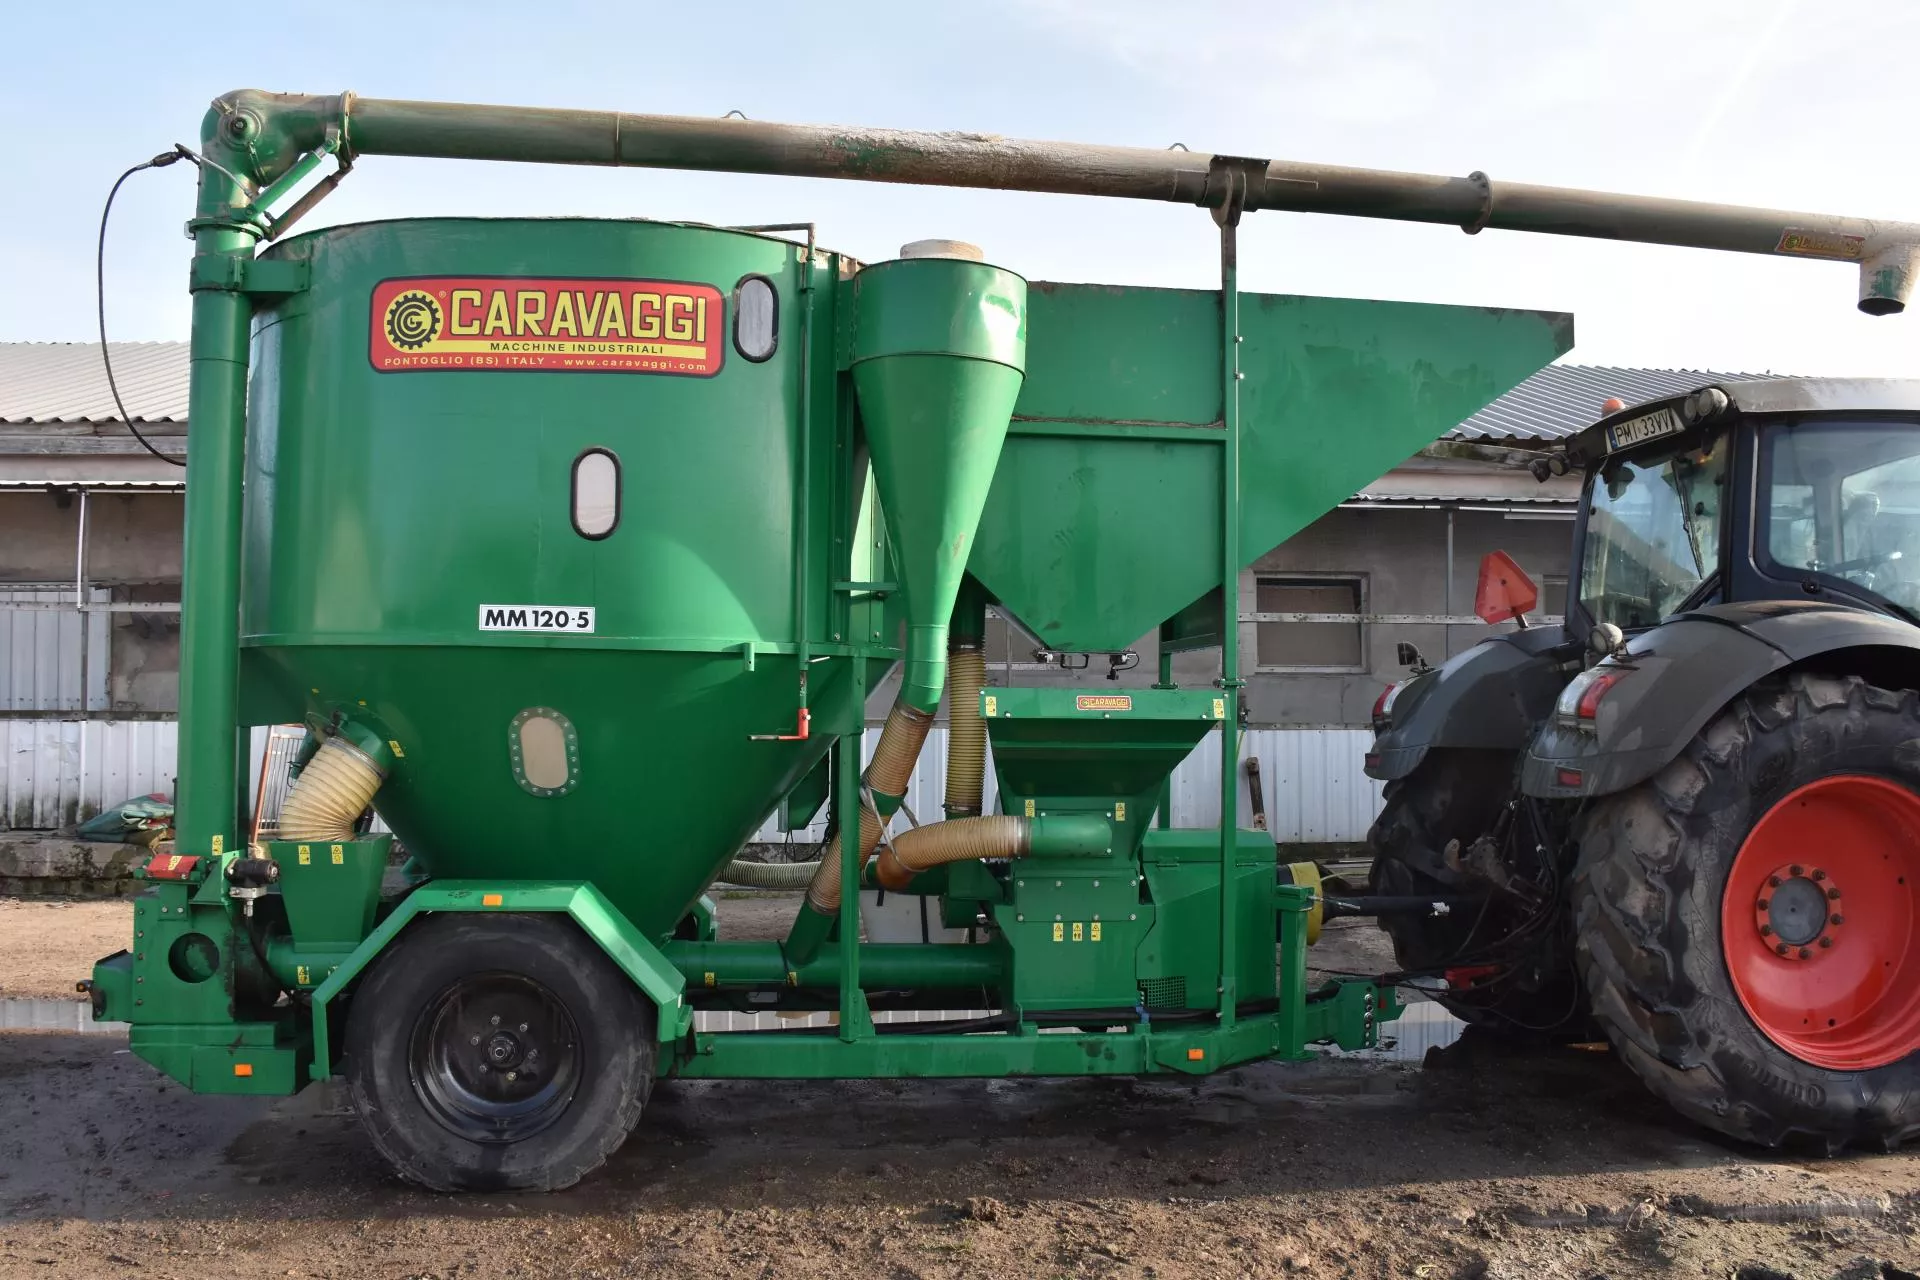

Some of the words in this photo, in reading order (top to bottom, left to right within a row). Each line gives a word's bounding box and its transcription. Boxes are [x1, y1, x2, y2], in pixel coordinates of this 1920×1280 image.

[451, 288, 706, 342] CARAVAGGI
[490, 342, 565, 352] MACCHINE
[572, 344, 664, 354] INDUSTRIALI
[384, 356, 463, 366] PONTOGLIO
[470, 356, 499, 366] (BS)
[506, 357, 545, 365] ITALY
[563, 358, 706, 371] www.caravaggi.com
[484, 609, 528, 627] MM
[1090, 698, 1128, 706] CARAVAGGI
